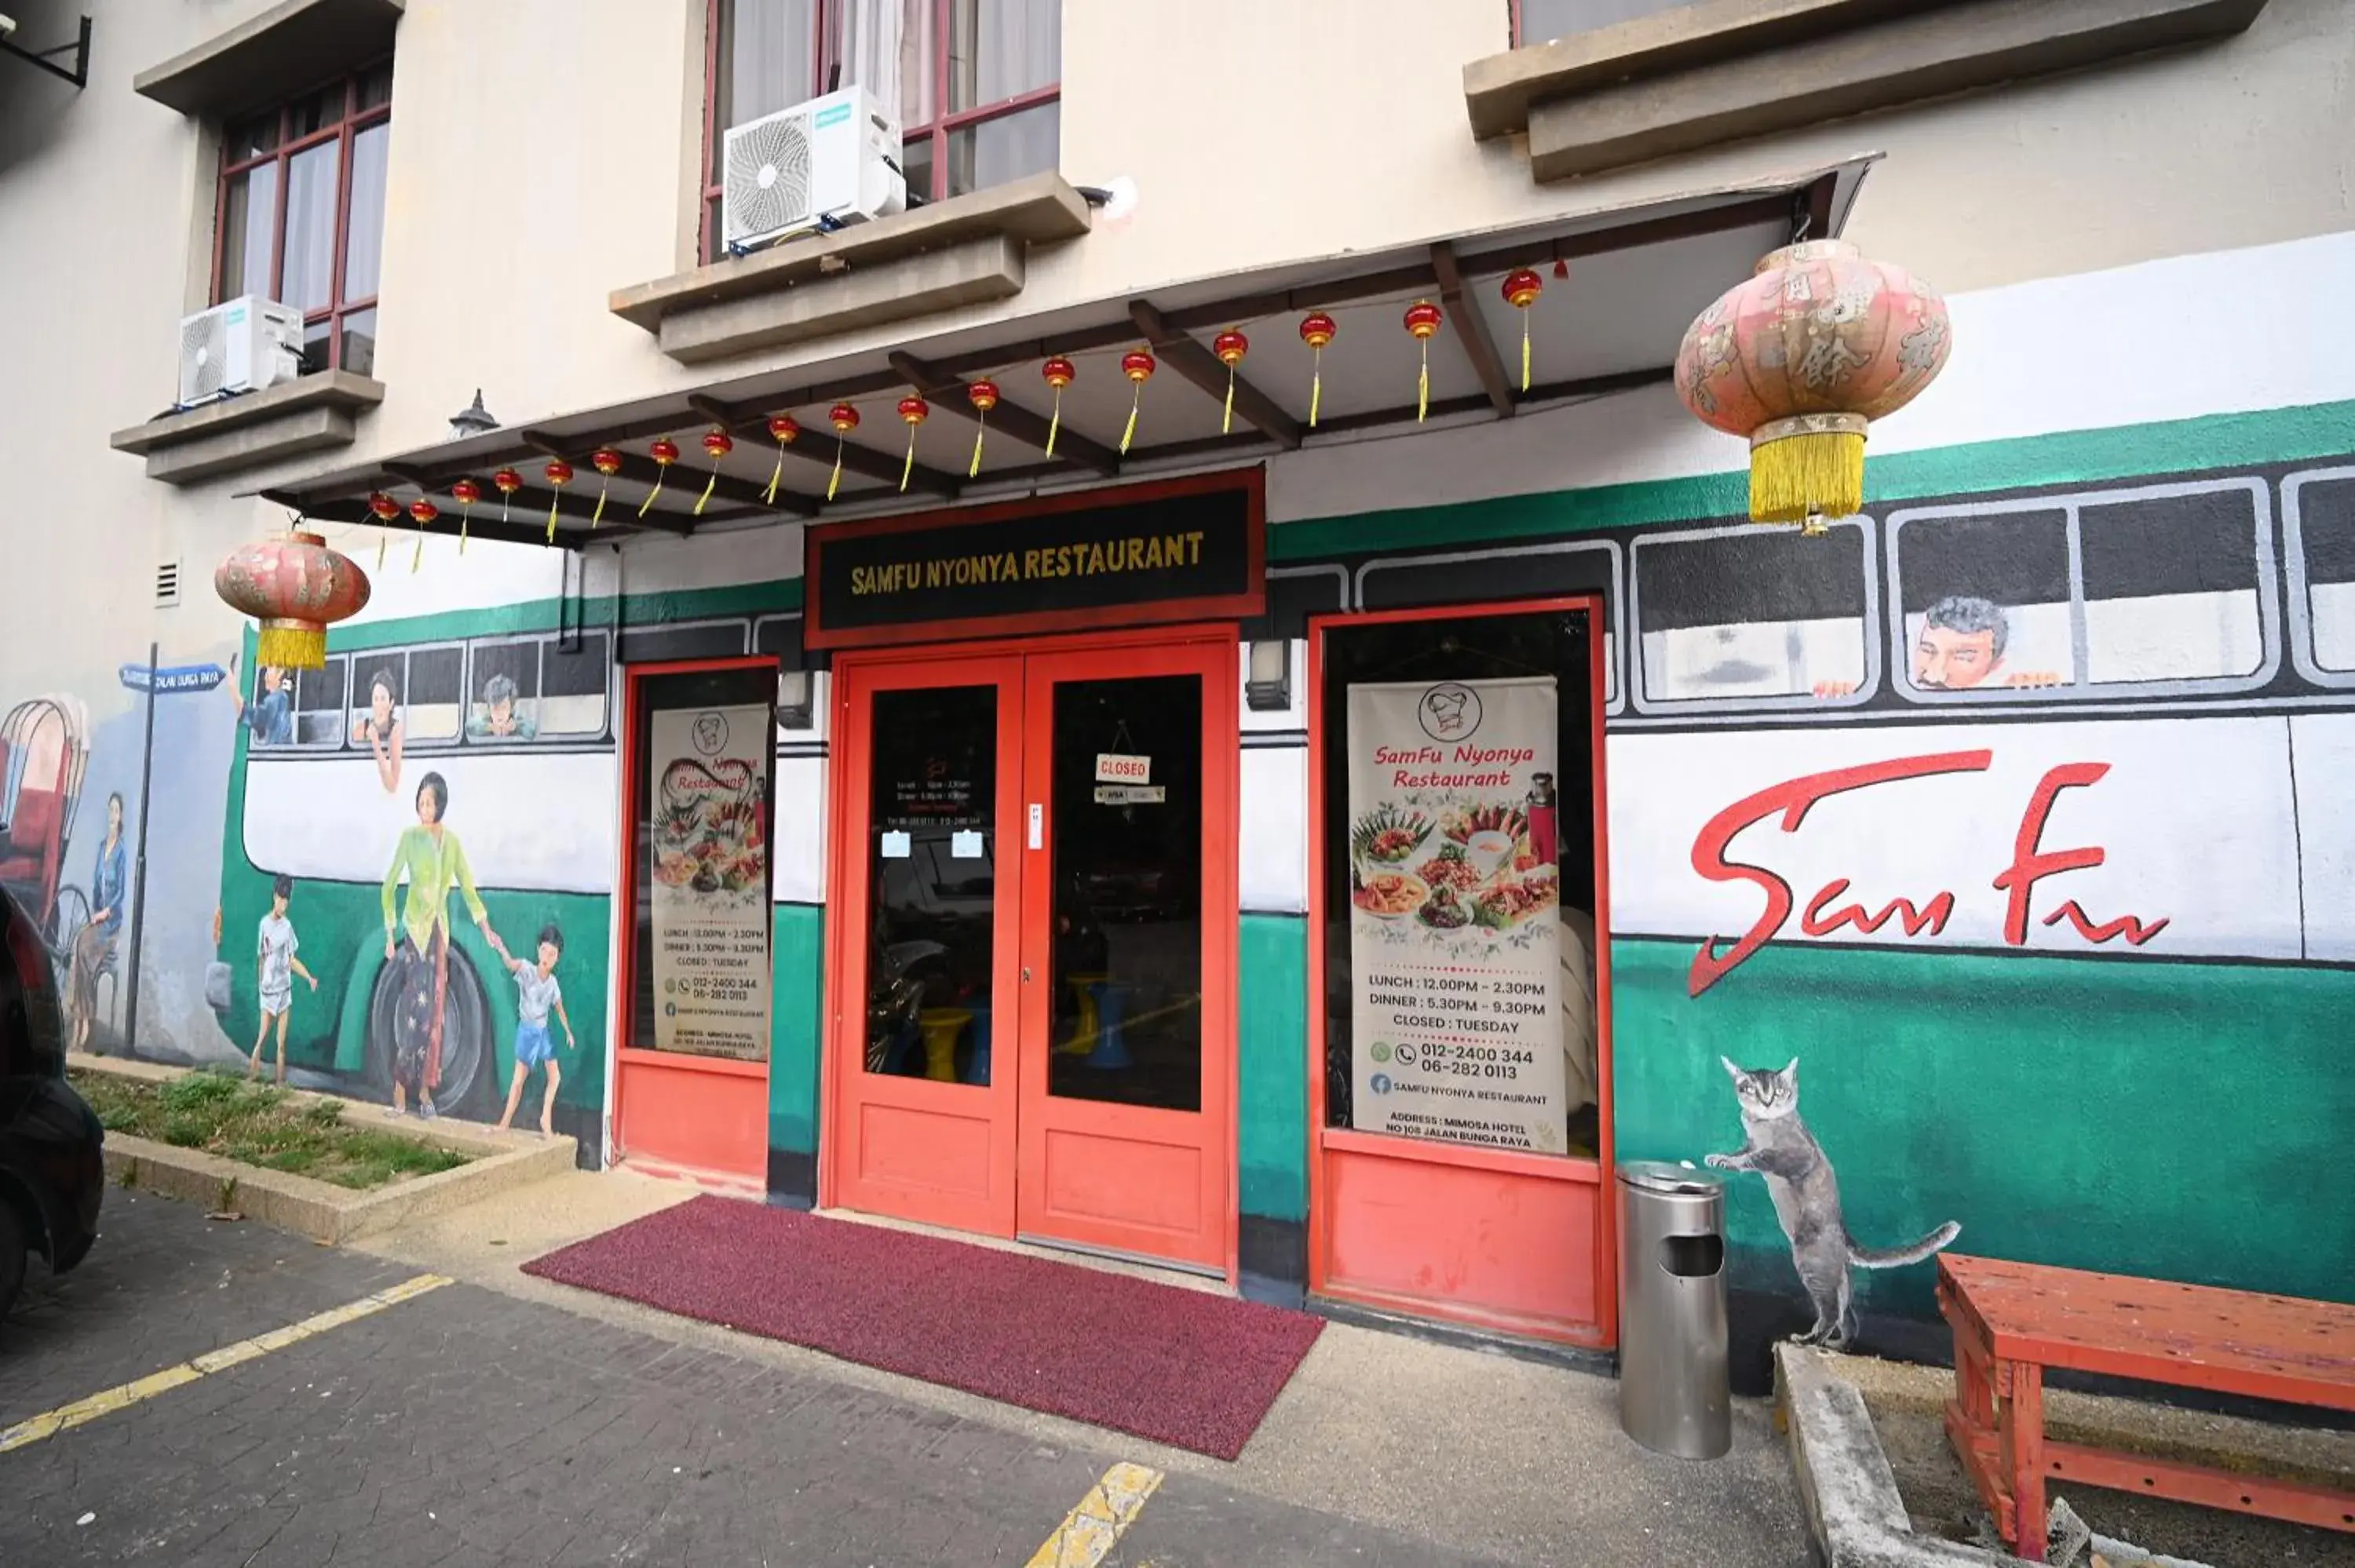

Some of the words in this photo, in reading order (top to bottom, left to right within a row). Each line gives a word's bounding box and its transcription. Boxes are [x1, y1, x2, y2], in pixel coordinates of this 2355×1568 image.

[852, 562, 921, 595] SAMFU
[927, 552, 1018, 589] NYONYA
[1024, 531, 1203, 579] RESTAURANT
[1374, 746, 1442, 765] SamFu
[1454, 744, 1535, 766] Nyonya
[1101, 760, 1145, 777] CLOSED
[1393, 770, 1511, 788] Restaurant
[1368, 975, 1413, 988] LUNCH
[1423, 978, 1478, 992] 12.00PM
[1493, 982, 1545, 995] 2.30PM
[1369, 994, 1417, 1008] DINNER
[1427, 997, 1477, 1012] 5.30PM
[1493, 1001, 1546, 1016] 9.30PM
[1393, 1014, 1445, 1029] CLOSED
[1455, 1019, 1519, 1034] TUESDAY
[1421, 1043, 1497, 1061] 012-2400
[1501, 1049, 1533, 1064] 344
[1421, 1059, 1481, 1076] 06-282
[1484, 1064, 1517, 1079] 0113
[1431, 1086, 1475, 1099] NYONYA
[1477, 1090, 1547, 1105] RESTAURANT
[1386, 1123, 1403, 1132] NO
[1423, 1127, 1458, 1140] JALAN
[1459, 1131, 1499, 1143] BUNGA
[1500, 1136, 1532, 1147] RAYA
[1444, 1117, 1489, 1131] MIMOSA
[1492, 1123, 1527, 1136] HOTEL
